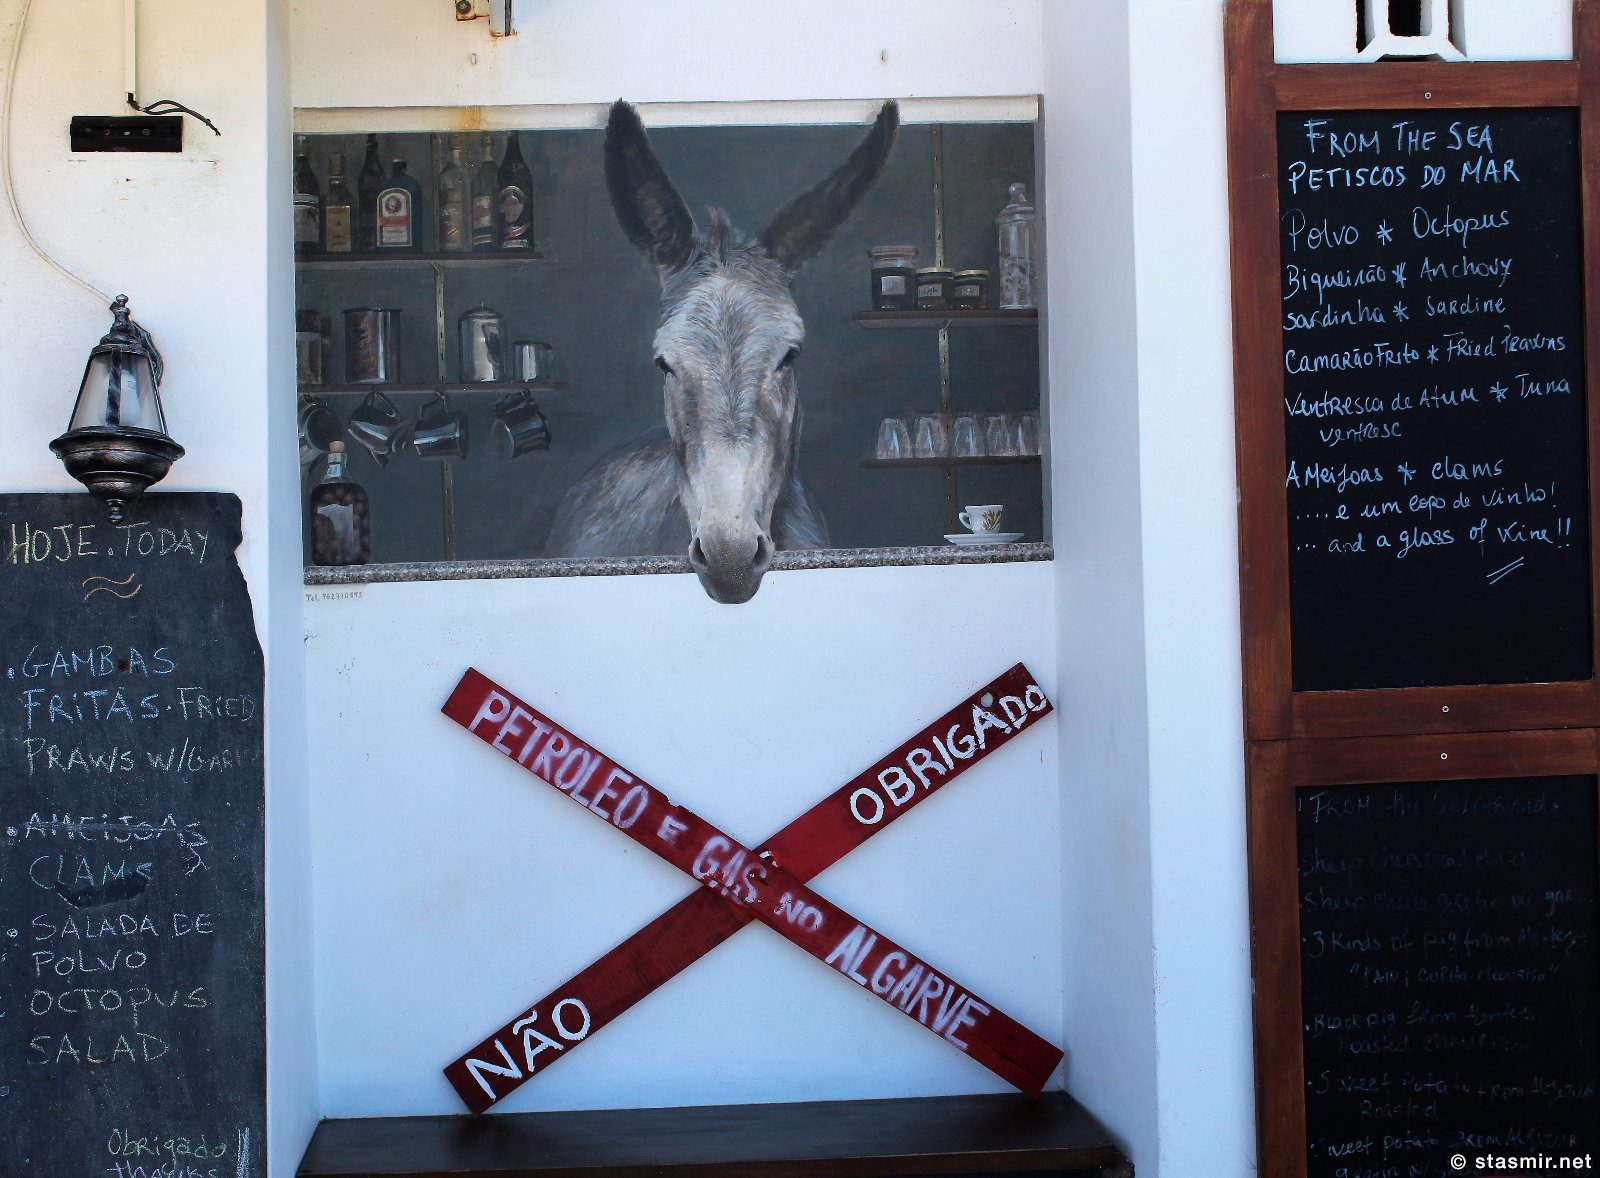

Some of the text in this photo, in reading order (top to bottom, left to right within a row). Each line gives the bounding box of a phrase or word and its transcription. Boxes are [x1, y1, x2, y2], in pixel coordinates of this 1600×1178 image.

[1304, 119, 1493, 157] FROM THE SEA
[1288, 155, 1520, 194] PETISCOS DO MAR
[1282, 204, 1510, 251] Polvo Octopus
[1420, 255, 1513, 287] Anchovy
[1391, 393, 1413, 410] de
[1515, 373, 1572, 398] Tuna
[1361, 500, 1402, 517] um
[1453, 491, 1471, 508] de
[8, 521, 209, 565] HOJE TODAY
[1376, 534, 1392, 548] a
[1396, 527, 1455, 558] glass
[1469, 517, 1488, 556] of
[22, 645, 176, 678] GAMBAS
[467, 689, 649, 829] PETROLEO
[774, 891, 825, 933] NO
[824, 924, 992, 1050] ALGARVE
[465, 684, 1048, 1102] NÃO OBRIGADO
[32, 913, 215, 941] SALADA DE
[32, 950, 147, 978] POLVO
[30, 986, 208, 1028] OCTOPUS
[25, 1032, 170, 1065] SALAD
